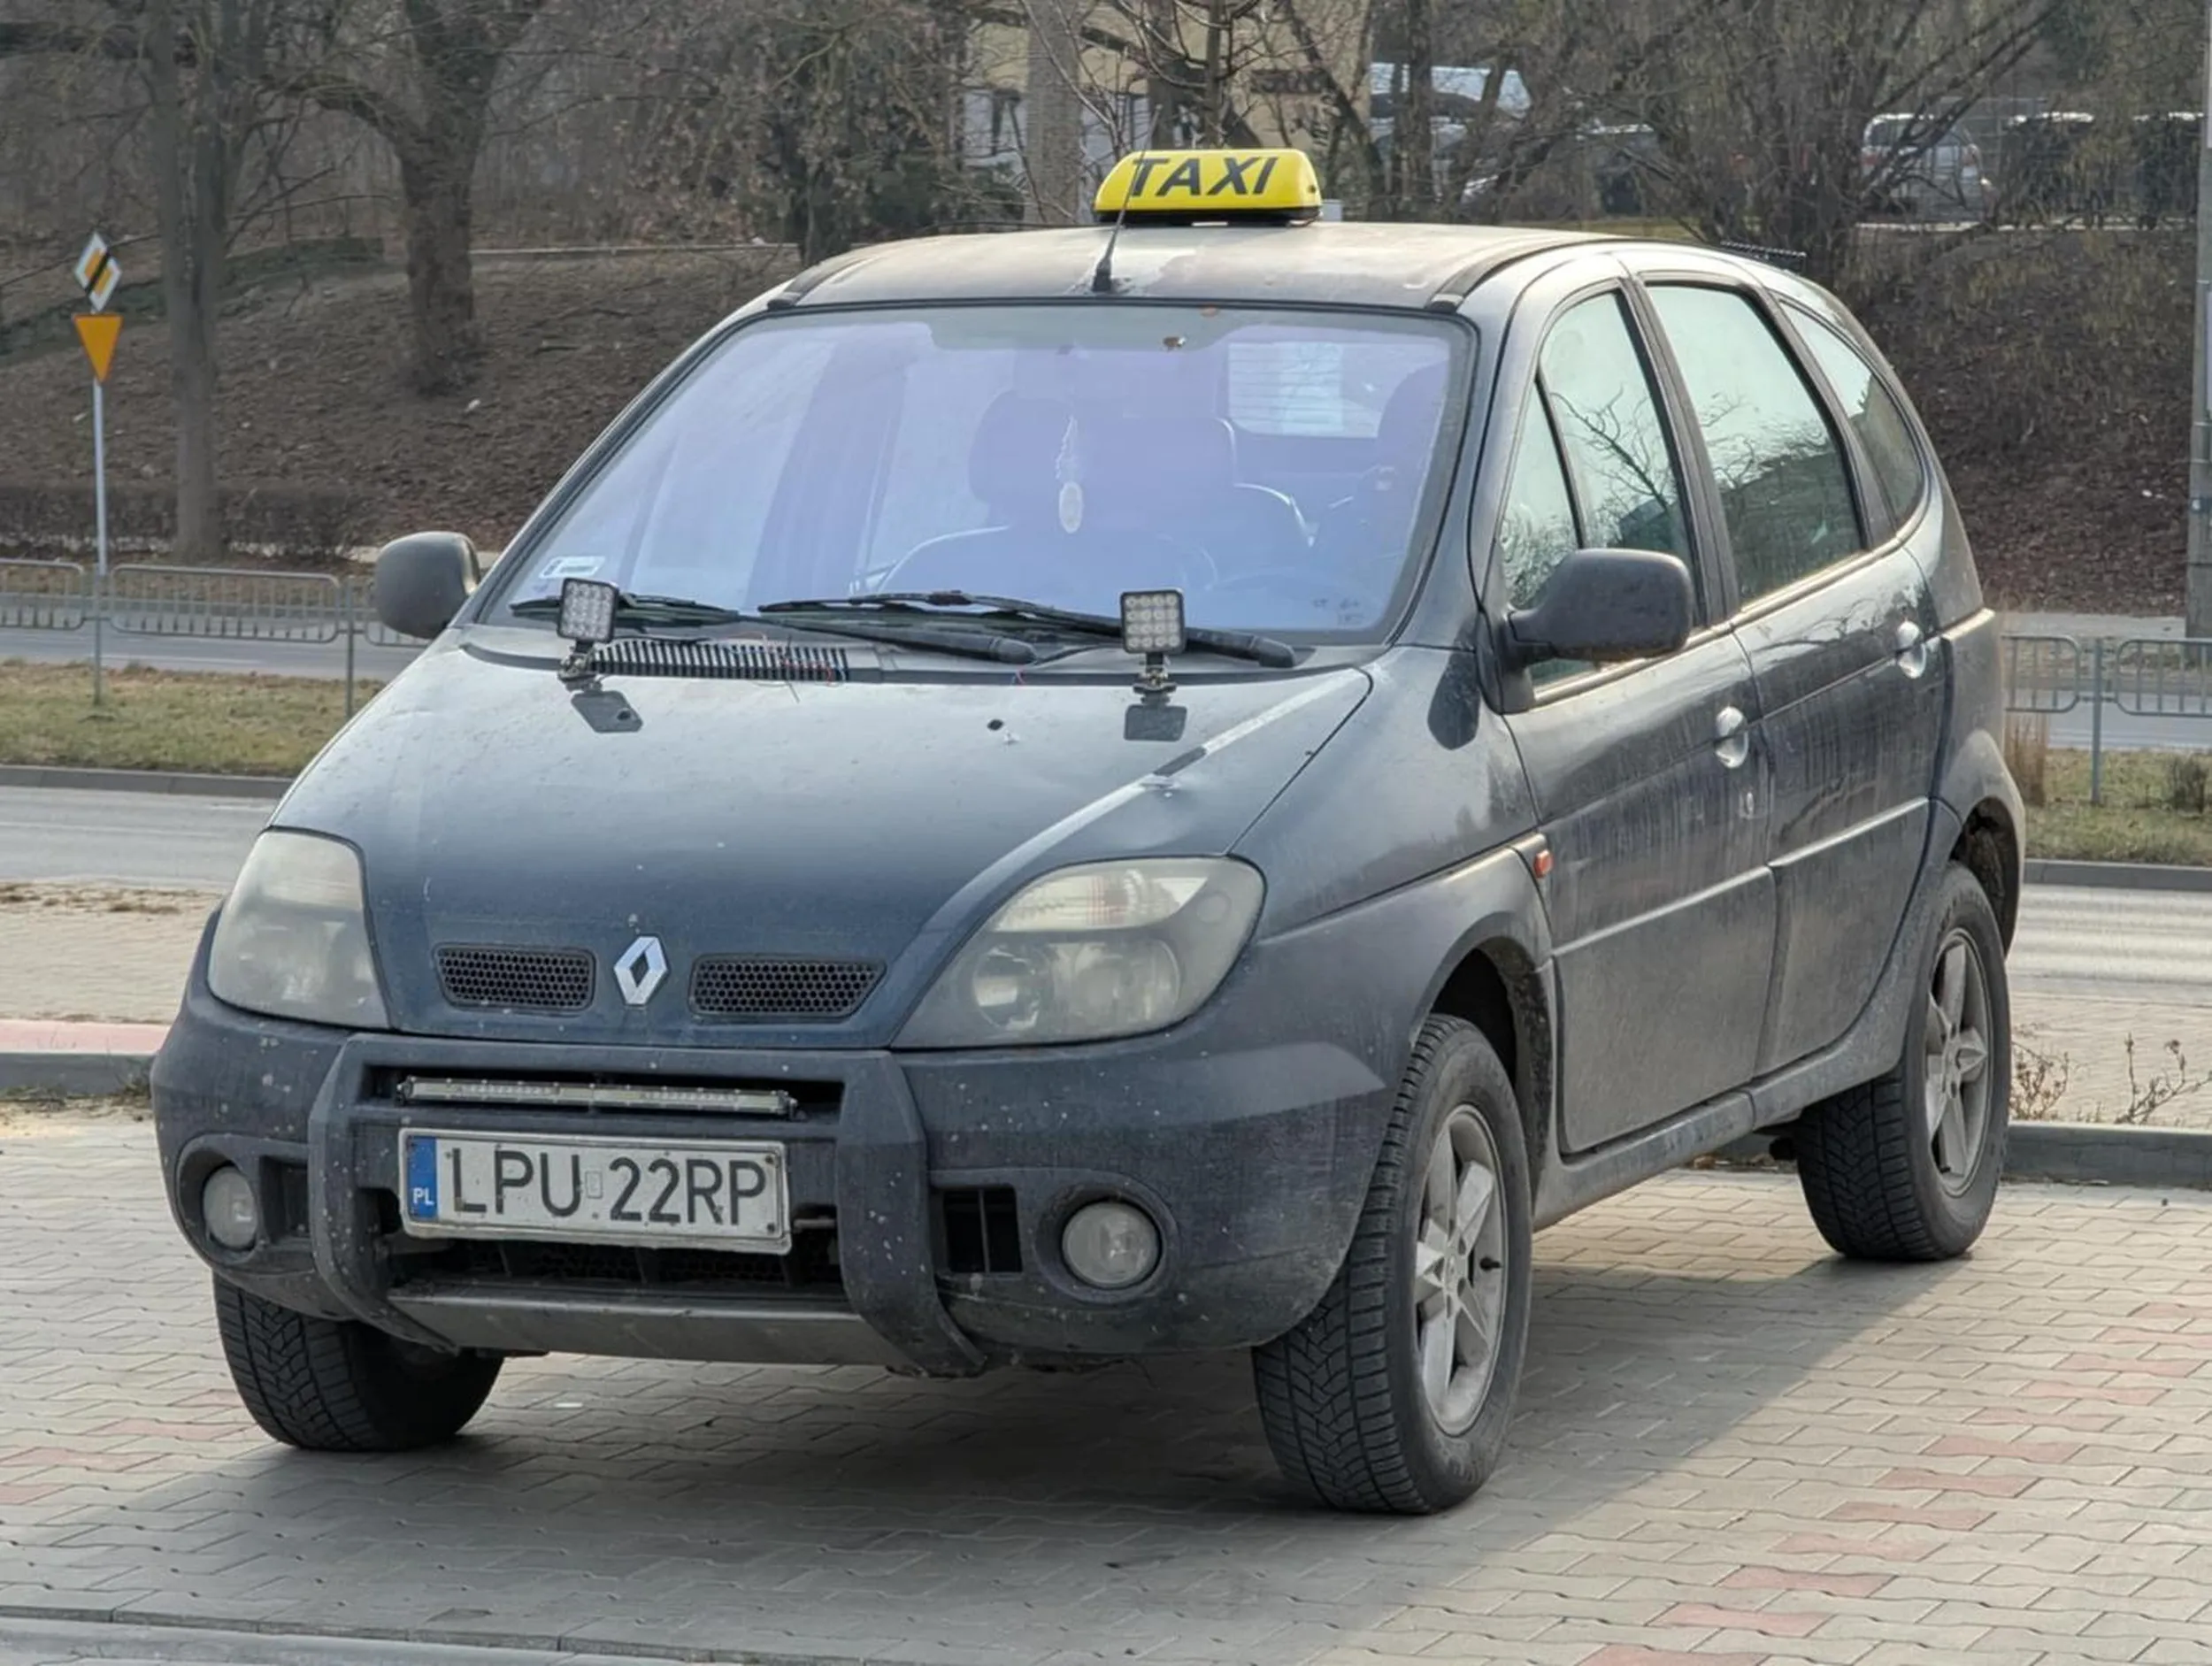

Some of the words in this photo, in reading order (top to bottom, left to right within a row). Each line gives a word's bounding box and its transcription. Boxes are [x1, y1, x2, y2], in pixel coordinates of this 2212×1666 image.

[1131, 156, 1279, 197] TAXI
[412, 1186, 435, 1206] PL
[451, 1148, 581, 1217] LPU
[609, 1157, 767, 1225] 22RP
